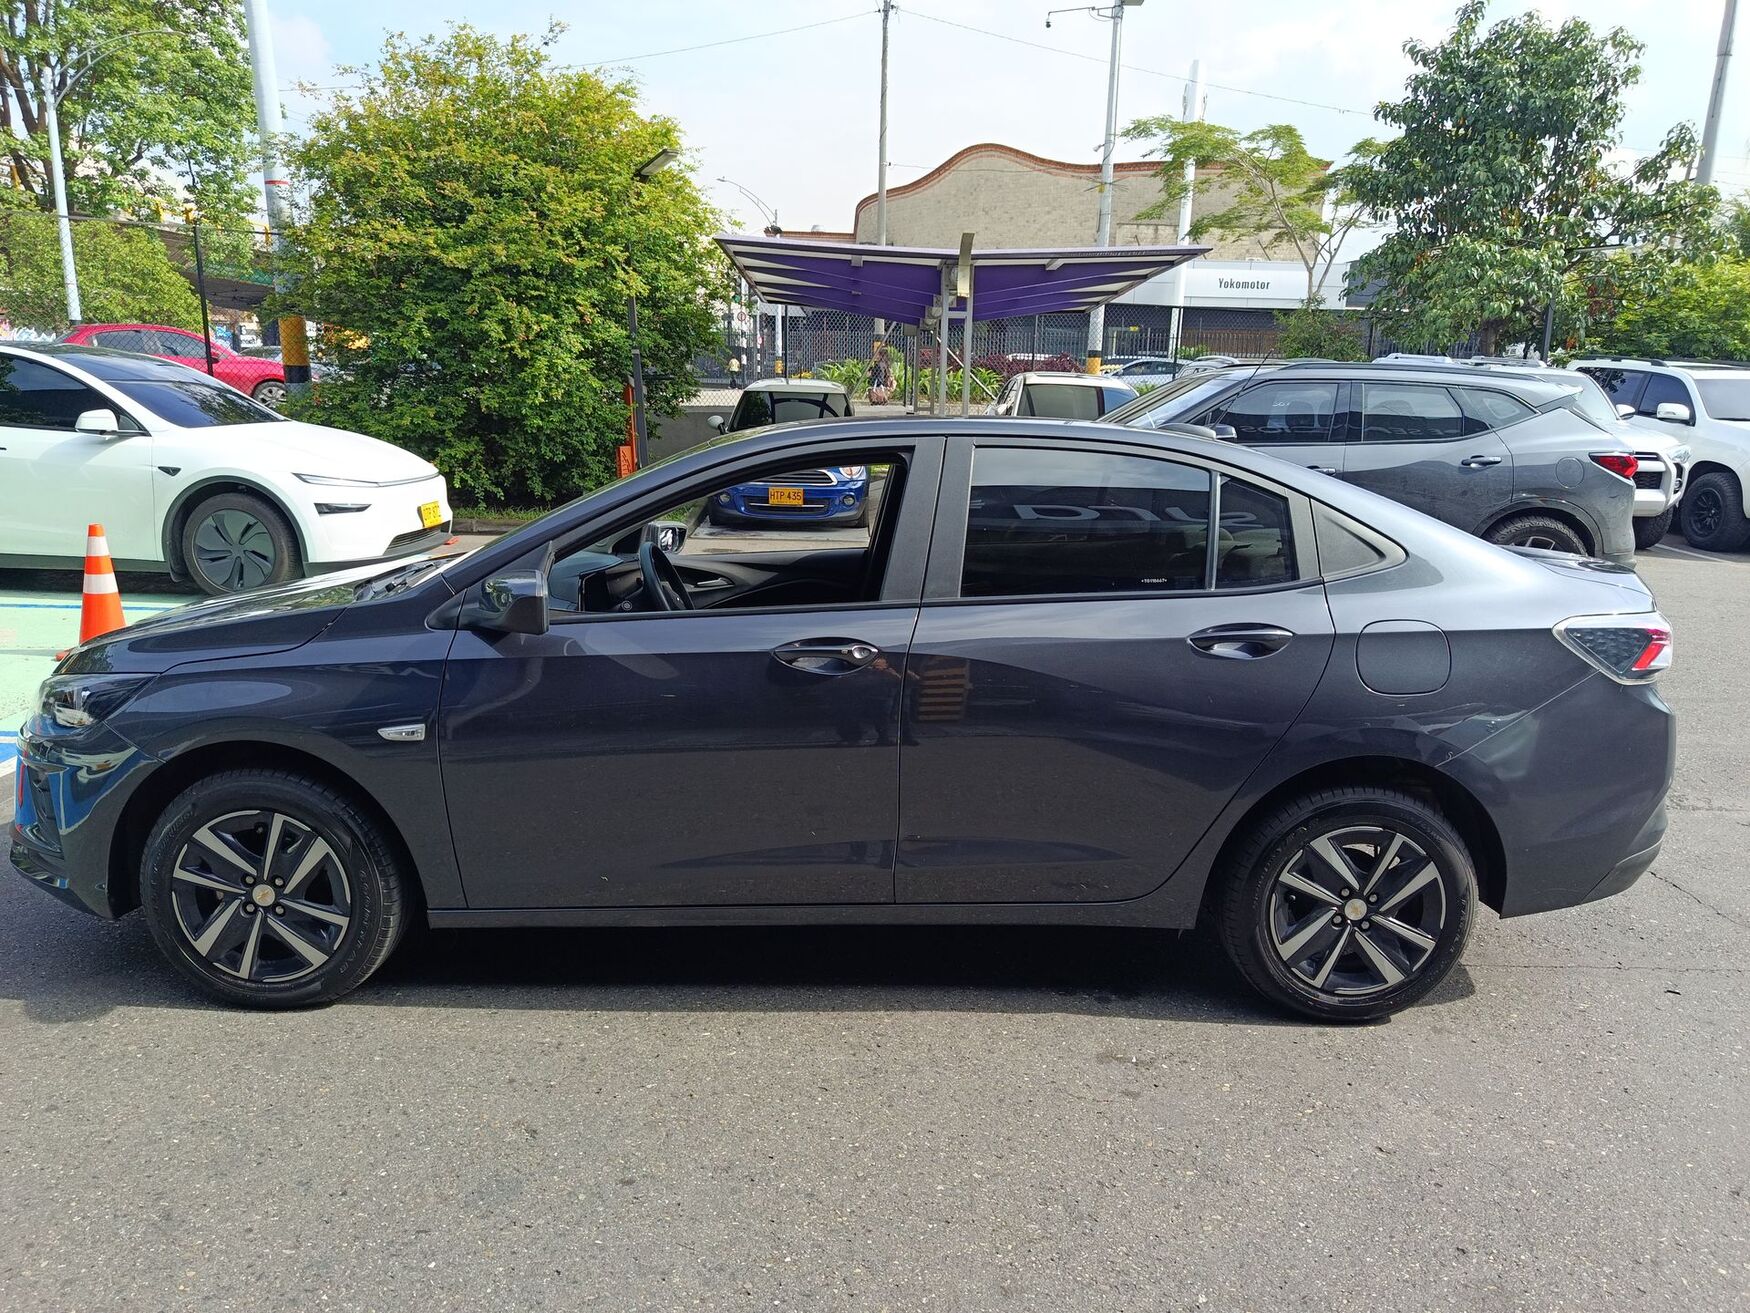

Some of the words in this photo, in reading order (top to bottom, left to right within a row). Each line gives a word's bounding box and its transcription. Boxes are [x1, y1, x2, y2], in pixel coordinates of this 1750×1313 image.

[1218, 278, 1271, 290] Yokomotor
[770, 491, 785, 501] HTP
[787, 491, 802, 501] 435
